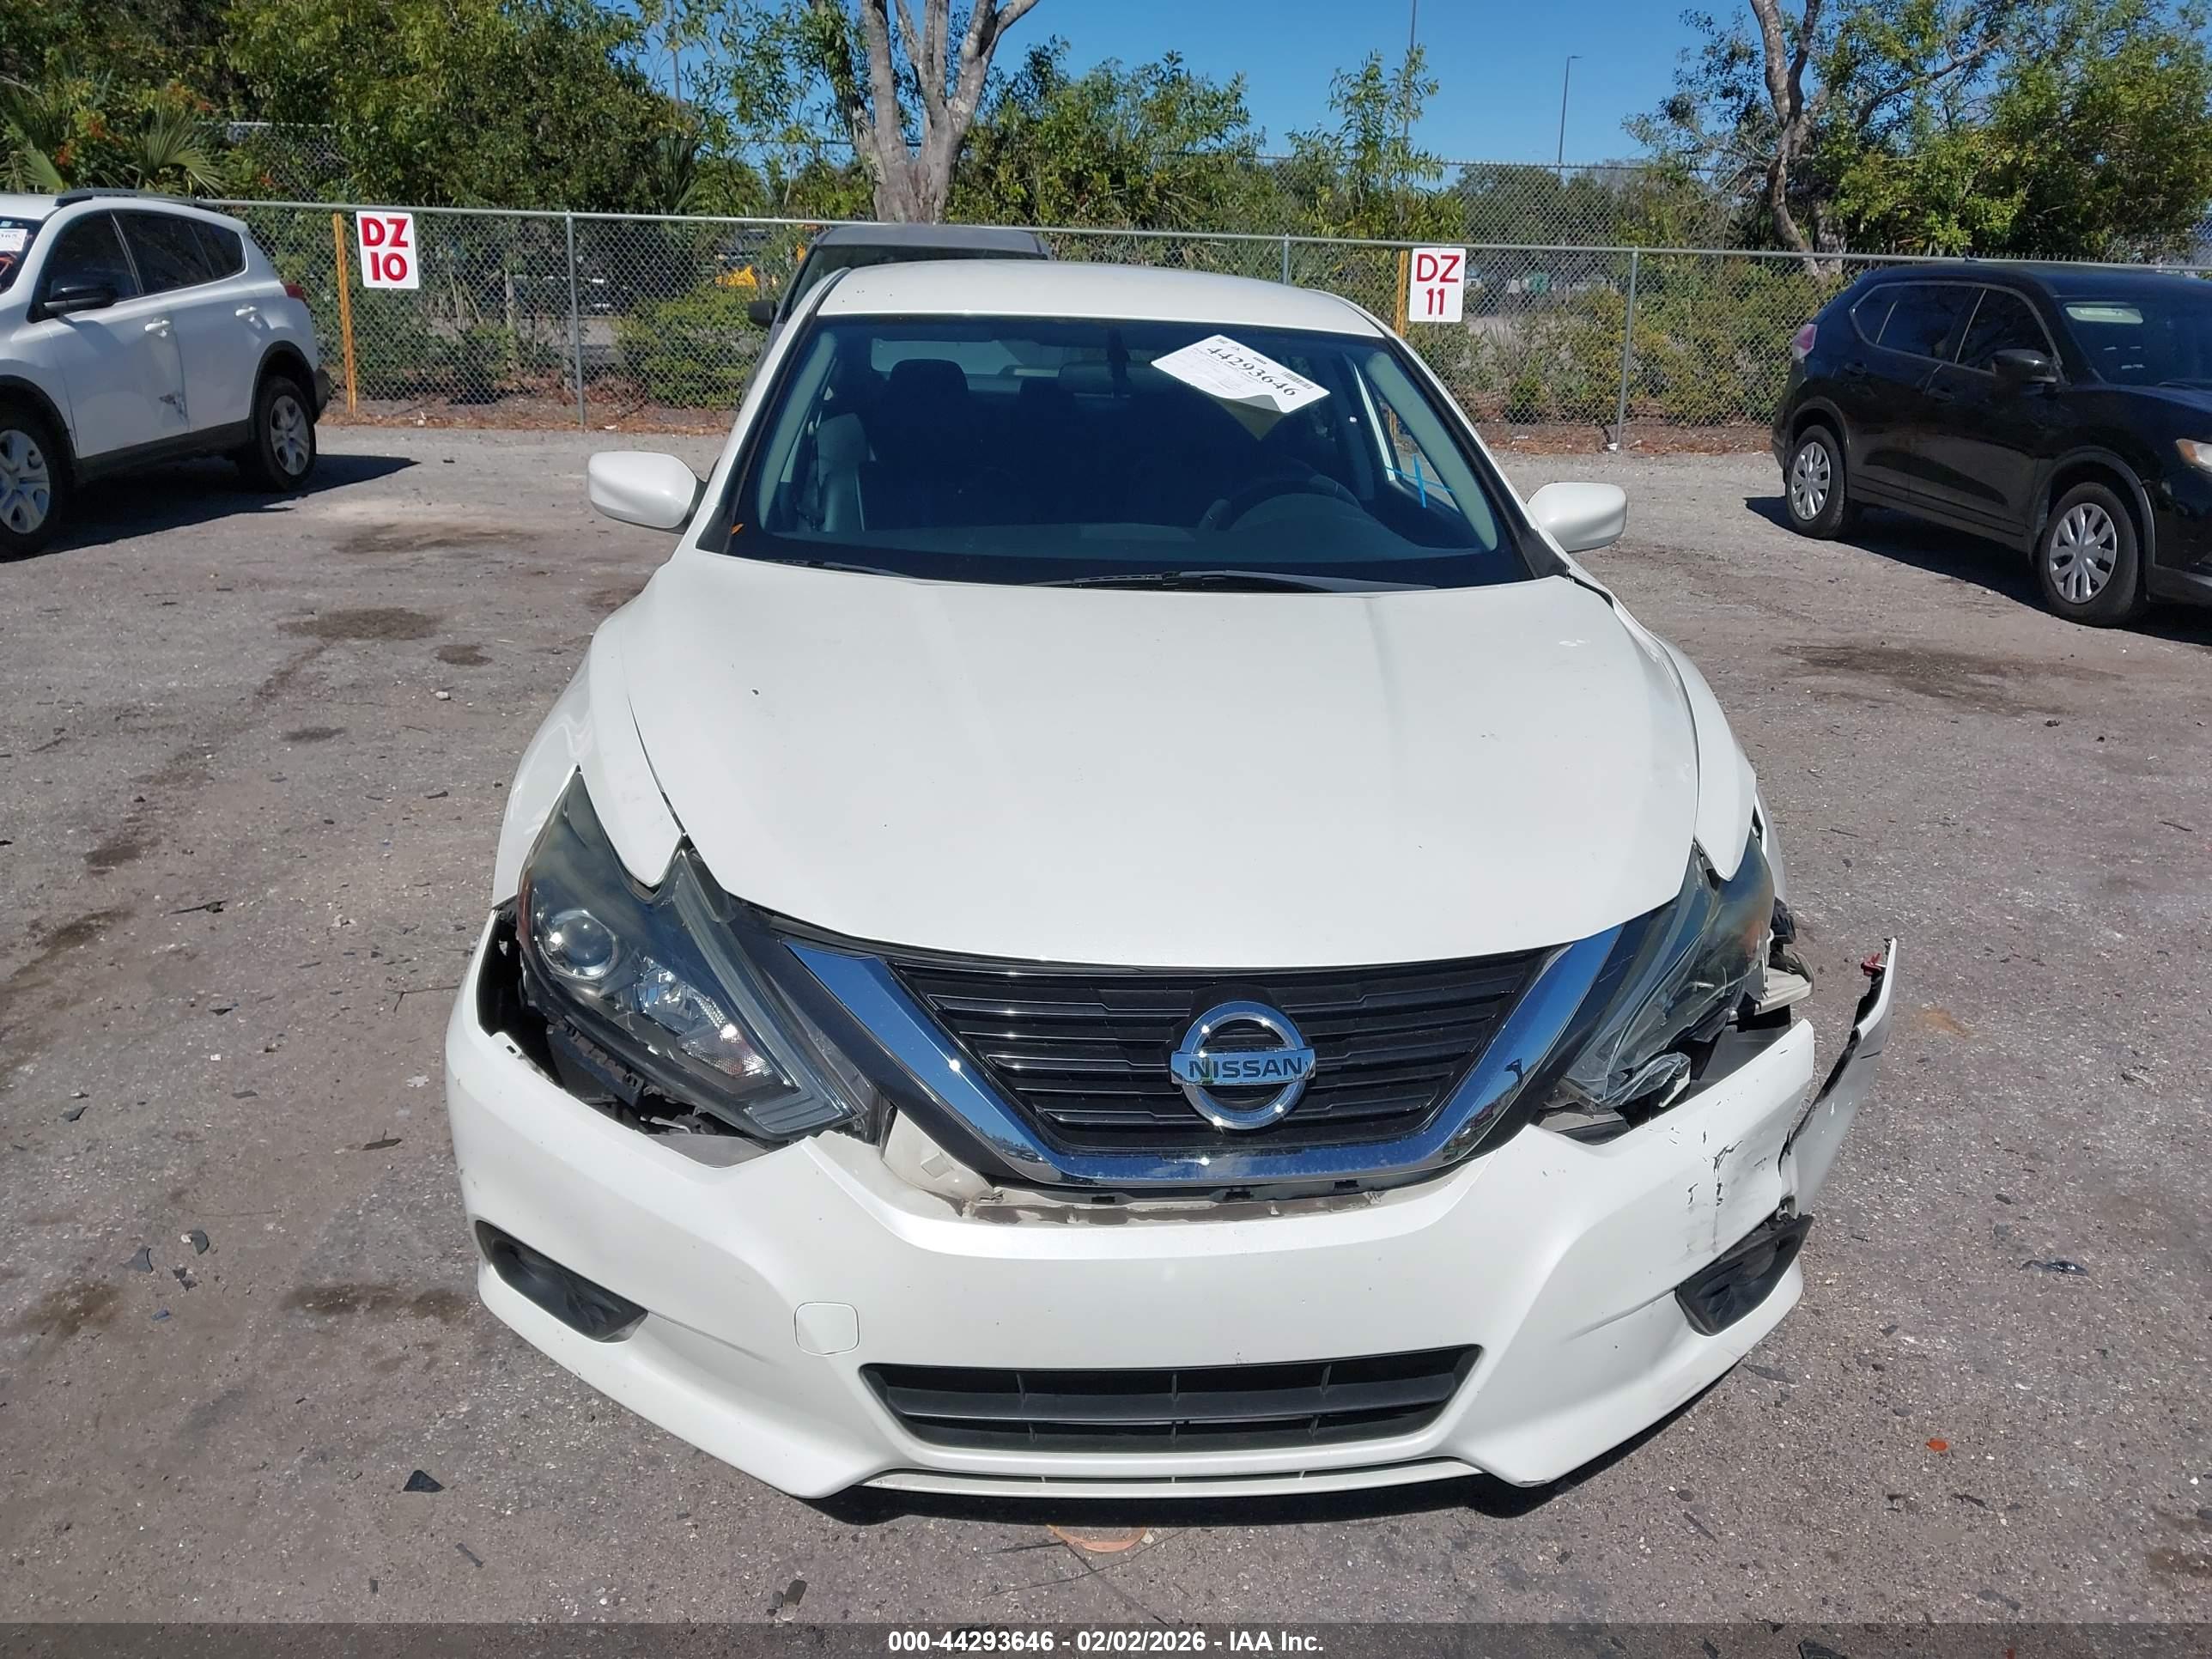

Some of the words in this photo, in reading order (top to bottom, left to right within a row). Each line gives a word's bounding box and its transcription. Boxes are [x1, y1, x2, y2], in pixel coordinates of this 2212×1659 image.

[361, 216, 409, 247] DZ
[1416, 254, 1461, 283] DZ
[1425, 288, 1445, 315] 11
[1206, 346, 1301, 397] 44293646
[1188, 1057, 1303, 1079] NISSAN
